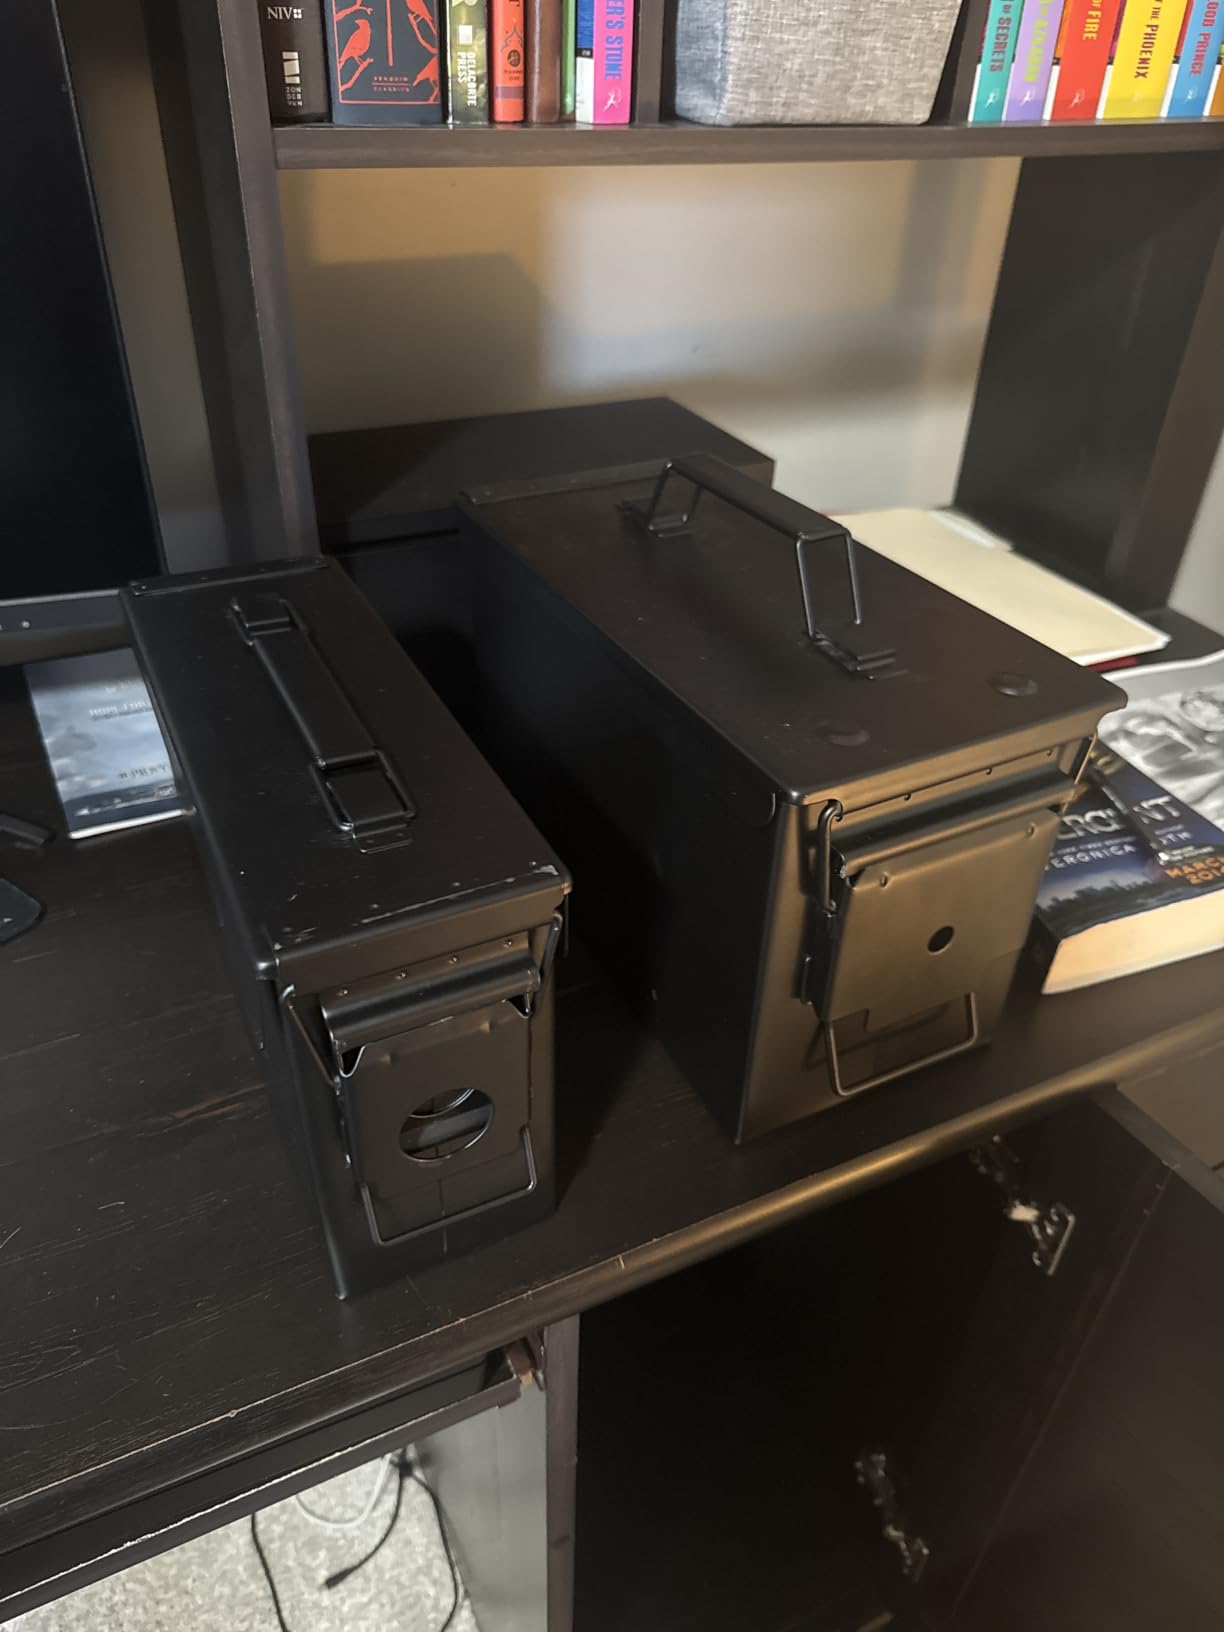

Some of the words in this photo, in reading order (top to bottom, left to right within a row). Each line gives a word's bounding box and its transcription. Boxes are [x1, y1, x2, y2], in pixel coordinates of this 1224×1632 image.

[267, 7, 292, 20] NIV
[605, 0, 625, 30] ER'S
[1082, 10, 1102, 41] FIRE
[1150, 7, 1161, 20] THE
[1202, 0, 1219, 27] OOD
[604, 35, 624, 80] STONE
[990, 17, 1012, 72] SECRETS
[1134, 24, 1159, 79] PHOENIX
[1190, 32, 1211, 75] PRINCE
[457, 51, 467, 84] PRESS
[467, 51, 477, 107] DELACORTE
[1045, 844, 1136, 870] ERONICA
